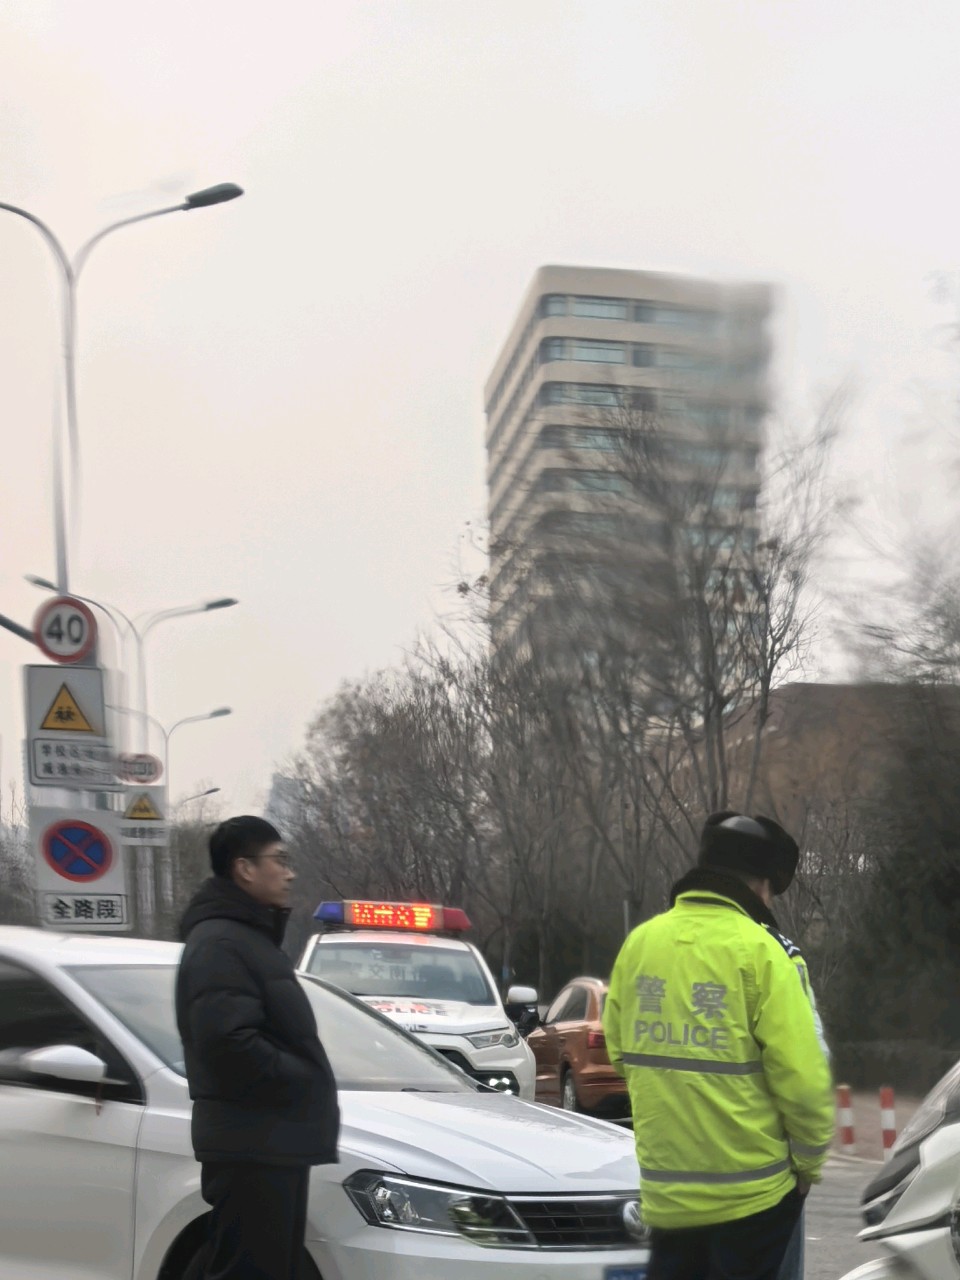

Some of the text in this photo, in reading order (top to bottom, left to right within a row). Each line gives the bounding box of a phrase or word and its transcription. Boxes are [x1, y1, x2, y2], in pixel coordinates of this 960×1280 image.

[46, 613, 84, 645] 40
[52, 898, 120, 919] 全路段
[635, 974, 729, 1019] 警察
[634, 1019, 729, 1050] POLICE
